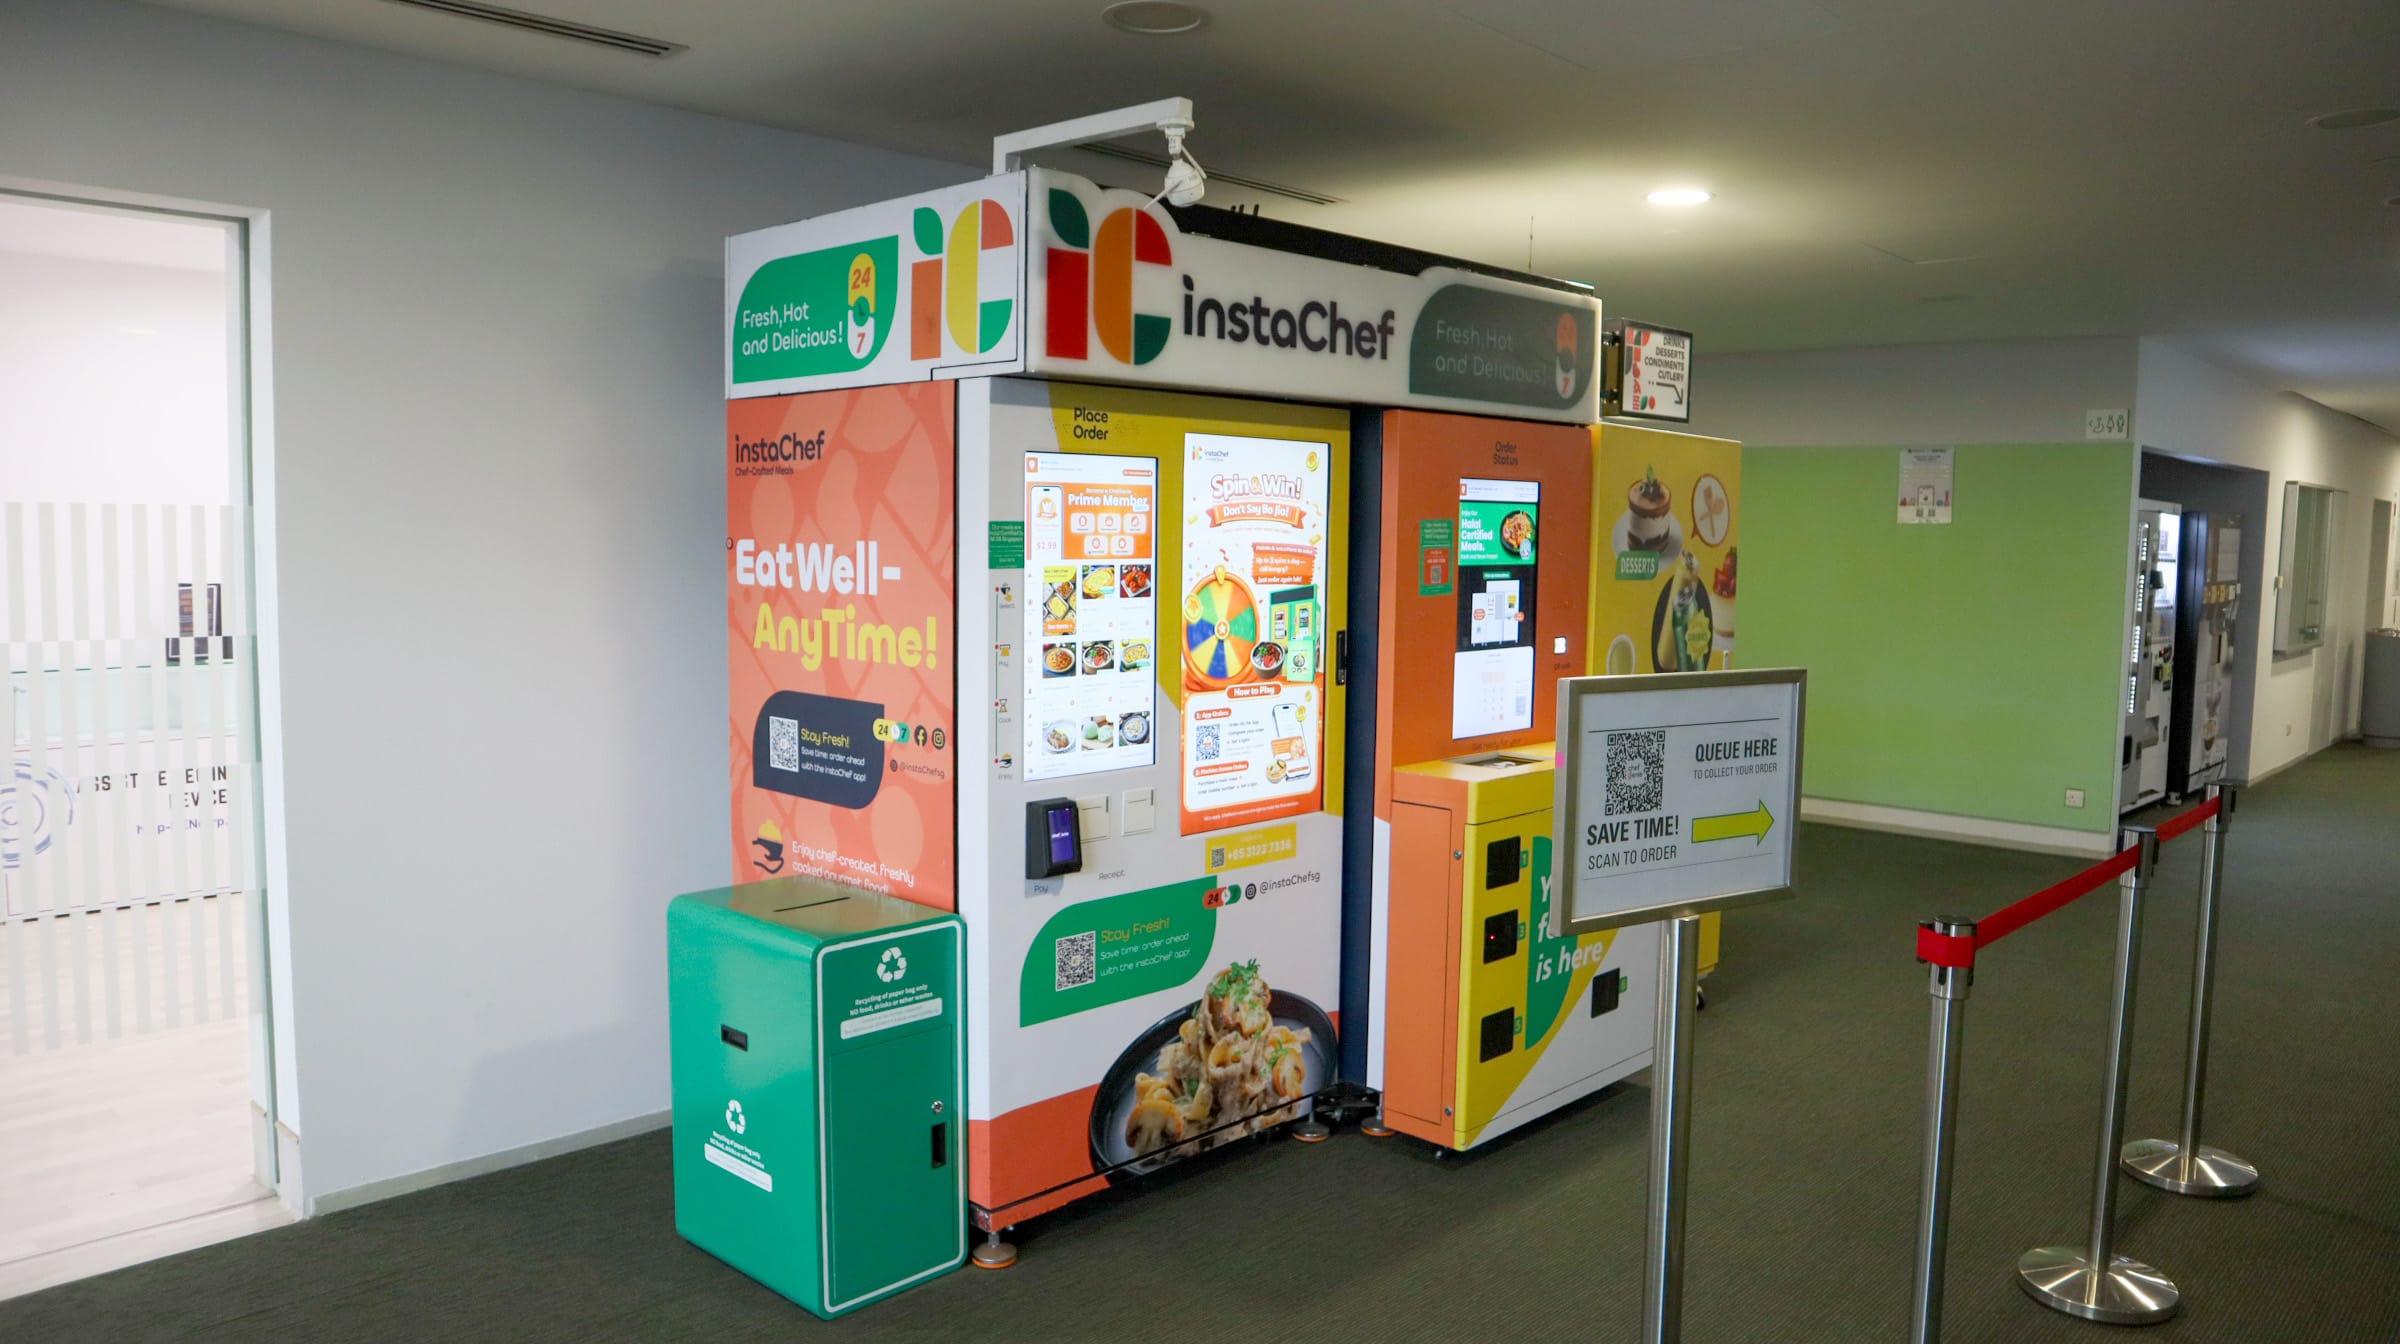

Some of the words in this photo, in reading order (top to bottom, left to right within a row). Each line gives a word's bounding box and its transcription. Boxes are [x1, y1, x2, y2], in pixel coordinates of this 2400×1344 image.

[851, 267, 872, 290] 24
[1182, 274, 1395, 361] instaChef
[742, 335, 768, 356] and
[773, 321, 843, 352] Delicious!
[856, 333, 865, 353] 7
[1663, 335, 1685, 349] DRINKS
[1656, 347, 1685, 360] DESSERTS
[1435, 353, 1467, 374] and
[1473, 356, 1547, 384] Delicious!
[1644, 356, 1685, 371] CONDIMENTS
[1658, 370, 1684, 382] CUTLERY
[1562, 377, 1571, 393] 7
[1074, 407, 1109, 423] Place
[1073, 424, 1109, 440] Order
[735, 430, 825, 463] instaChef
[1495, 441, 1517, 454] Order
[1493, 454, 1518, 466] Status
[1211, 473, 1250, 501] Spin
[1251, 476, 1262, 494] &
[1261, 474, 1303, 500] Win!
[1068, 493, 1101, 506] Prime
[1103, 494, 1149, 506] Member
[1223, 504, 1246, 517] Don't
[1246, 504, 1261, 515] Say
[1461, 519, 1481, 528] Halal
[1461, 530, 1493, 541] Certified
[1461, 541, 1485, 551] Meals.
[735, 538, 793, 589] Eat
[1621, 557, 1656, 574] DESSERTS
[753, 602, 937, 672] AnyTime!
[1234, 687, 1250, 697] How
[1251, 687, 1259, 695] to
[1260, 685, 1275, 695] Play
[800, 727, 821, 746] Stay
[822, 731, 850, 748] Fresh!
[878, 724, 888, 736] 24
[901, 728, 907, 738] 7
[801, 746, 815, 755] Save
[829, 752, 845, 762] order
[846, 755, 865, 766] ahead
[1695, 741, 1740, 763] QUEUE
[1744, 738, 1777, 758] HERE
[801, 762, 814, 772] with
[814, 763, 824, 773] the
[825, 765, 853, 779] instaChef
[1693, 770, 1703, 780] TO
[1704, 766, 1734, 779] COLLECT
[1735, 765, 1754, 777] YOUR
[1755, 762, 1778, 775] ORDER
[1587, 821, 1629, 846] SAVE
[1634, 815, 1679, 838] TIME!
[792, 841, 816, 860] Enjoy
[879, 863, 915, 888] freshly
[1588, 852, 1620, 870] SCAN
[1624, 850, 1637, 864] TO
[1640, 845, 1677, 863] ORDER
[792, 861, 823, 878] cooked
[1034, 885, 1049, 893] Pay
[1260, 871, 1321, 894] @instaChefsg
[1208, 893, 1219, 905] 24
[1231, 888, 1238, 900] 7
[1101, 928, 1130, 943] Stay
[1133, 917, 1170, 936] Fresh!
[1100, 950, 1119, 960] Save
[1142, 939, 1164, 950] order
[1165, 933, 1189, 944] ahead
[1100, 966, 1118, 977] with
[1120, 963, 1134, 971] the
[1136, 951, 1173, 967] instaChef
[1535, 954, 1552, 983] is
[1557, 941, 1603, 975] here
[855, 995, 881, 1005] Recycling
[888, 990, 904, 999] paper
[874, 1001, 892, 1010] drinks
[899, 996, 914, 1004] other
